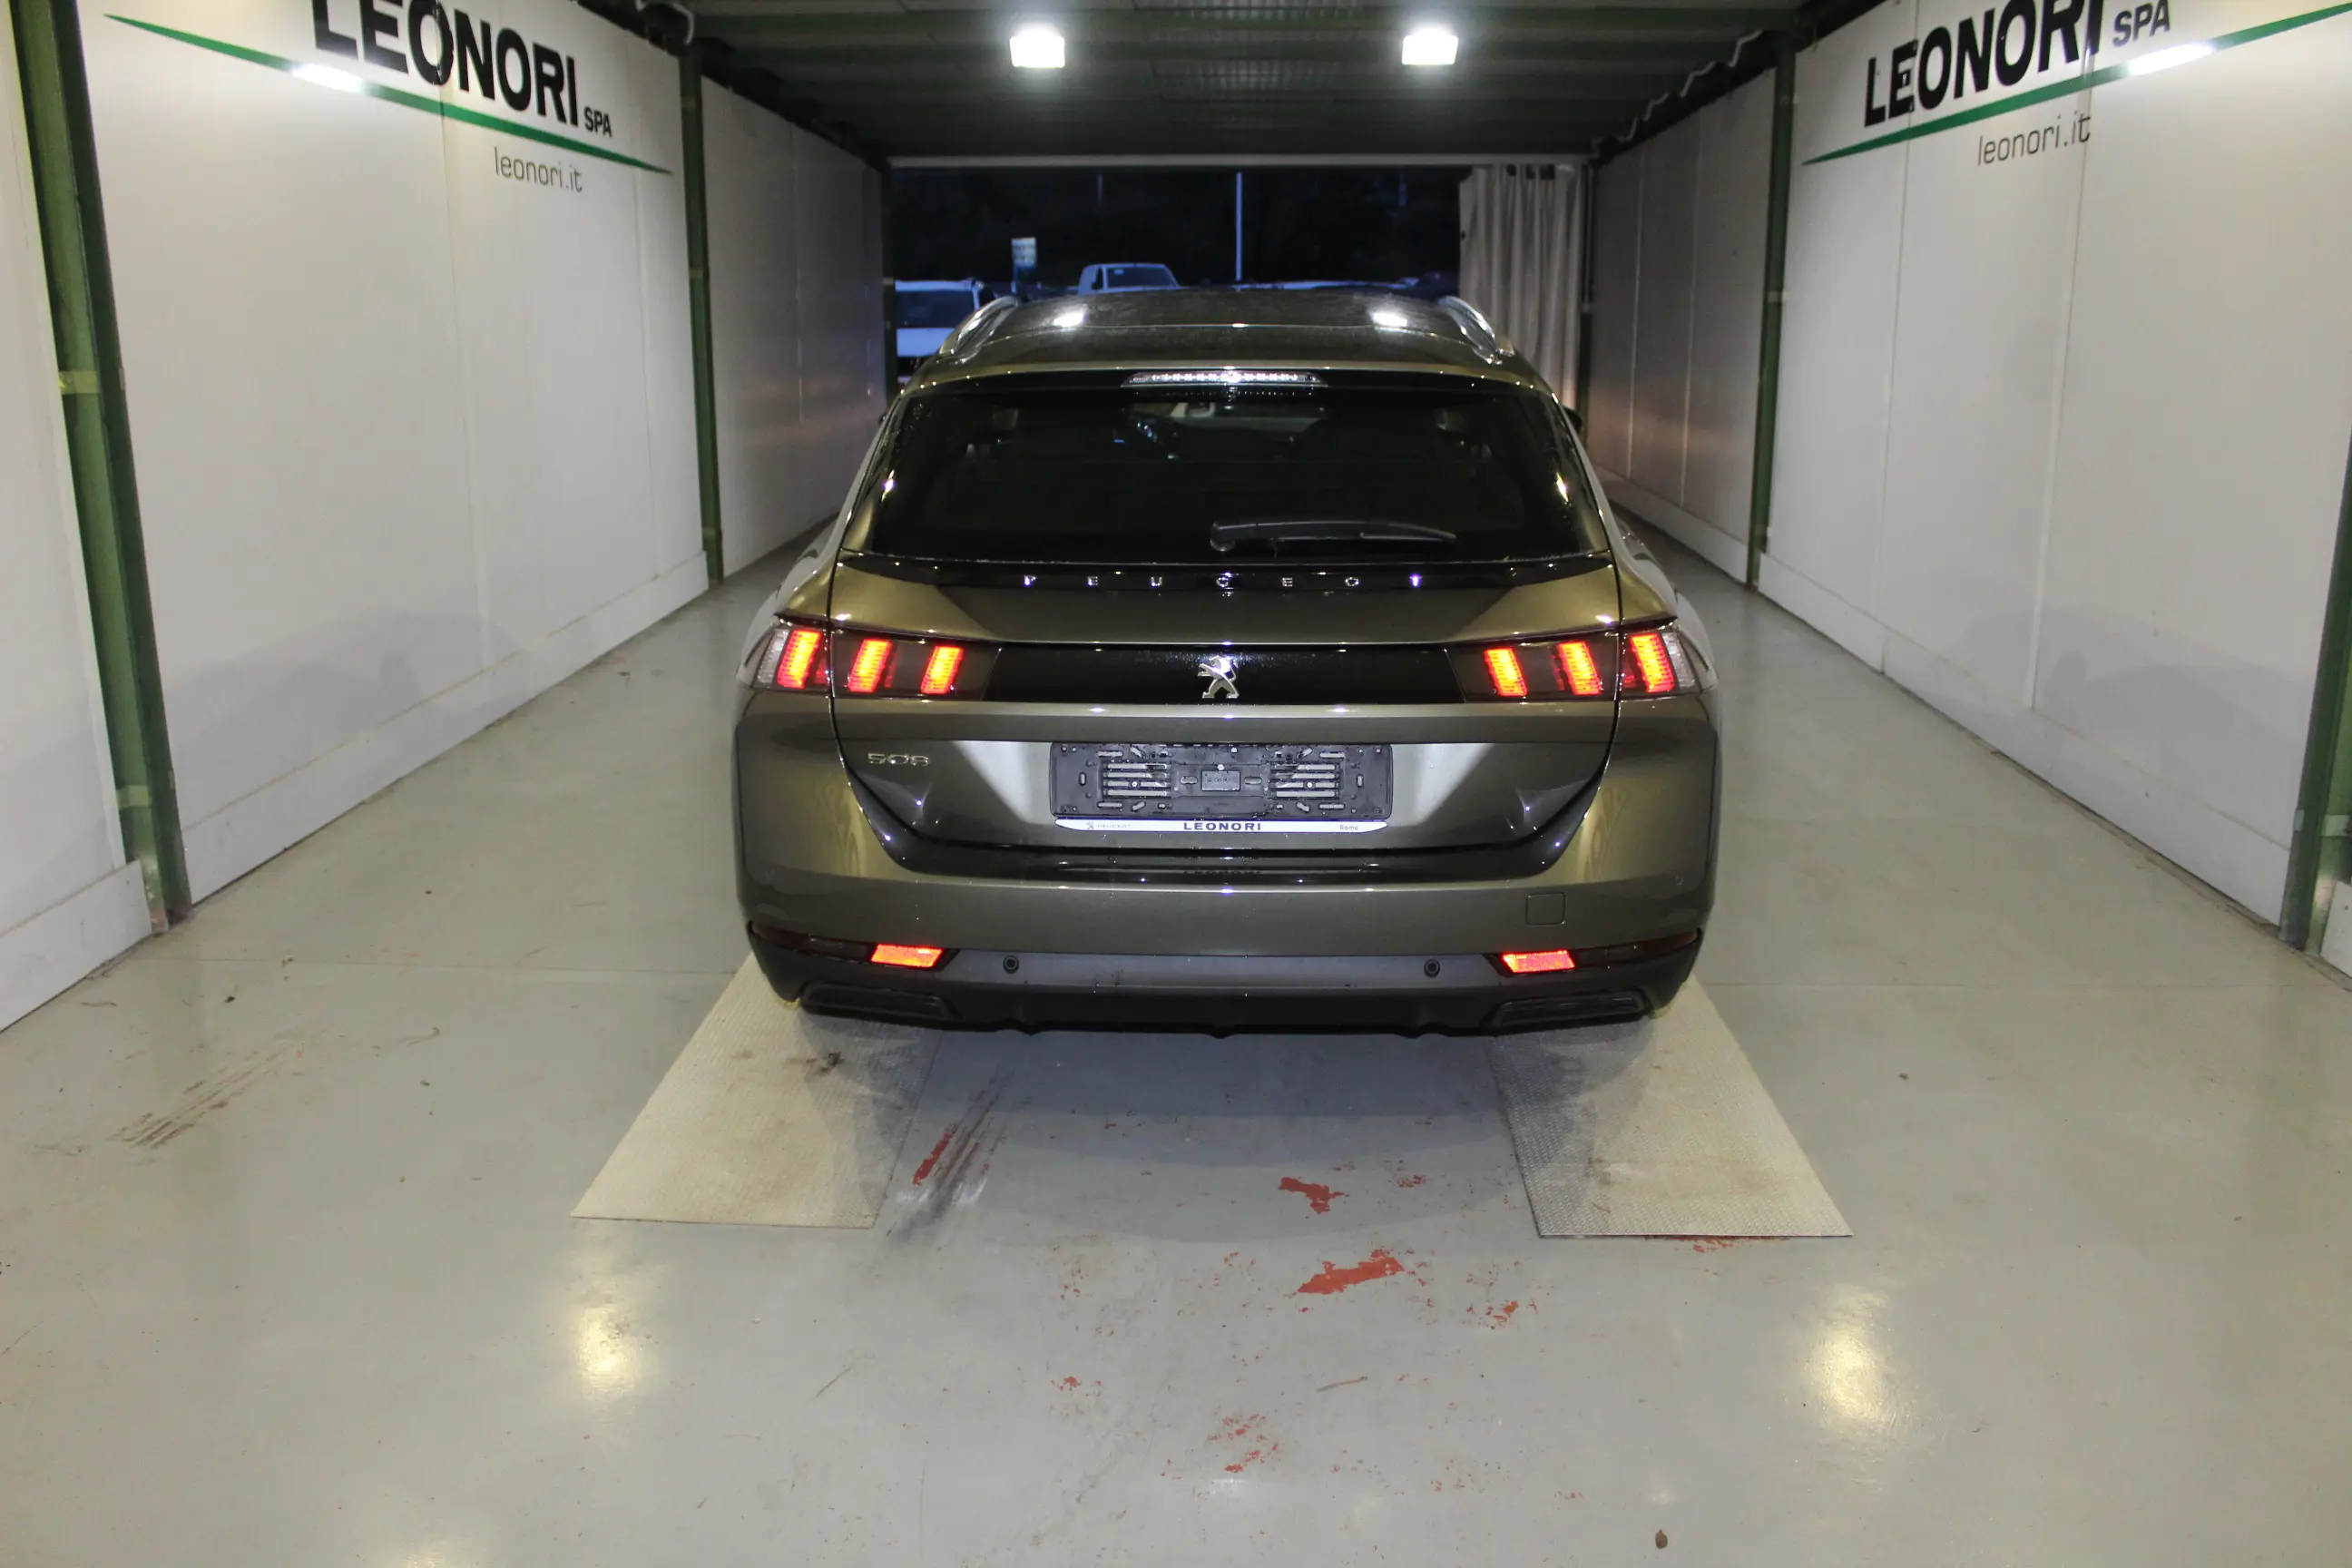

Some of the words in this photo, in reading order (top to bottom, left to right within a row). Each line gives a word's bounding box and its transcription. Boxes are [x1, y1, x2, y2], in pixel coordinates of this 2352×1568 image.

[312, 0, 578, 126] LEONORI
[583, 106, 612, 138] SPA
[1864, 0, 2103, 127] LEONORI
[2112, 0, 2171, 47] SPA
[1977, 111, 2091, 166] leonori.it
[494, 146, 583, 193] leonori.it
[867, 752, 930, 766] 508
[1183, 821, 1261, 831] LEONORI
